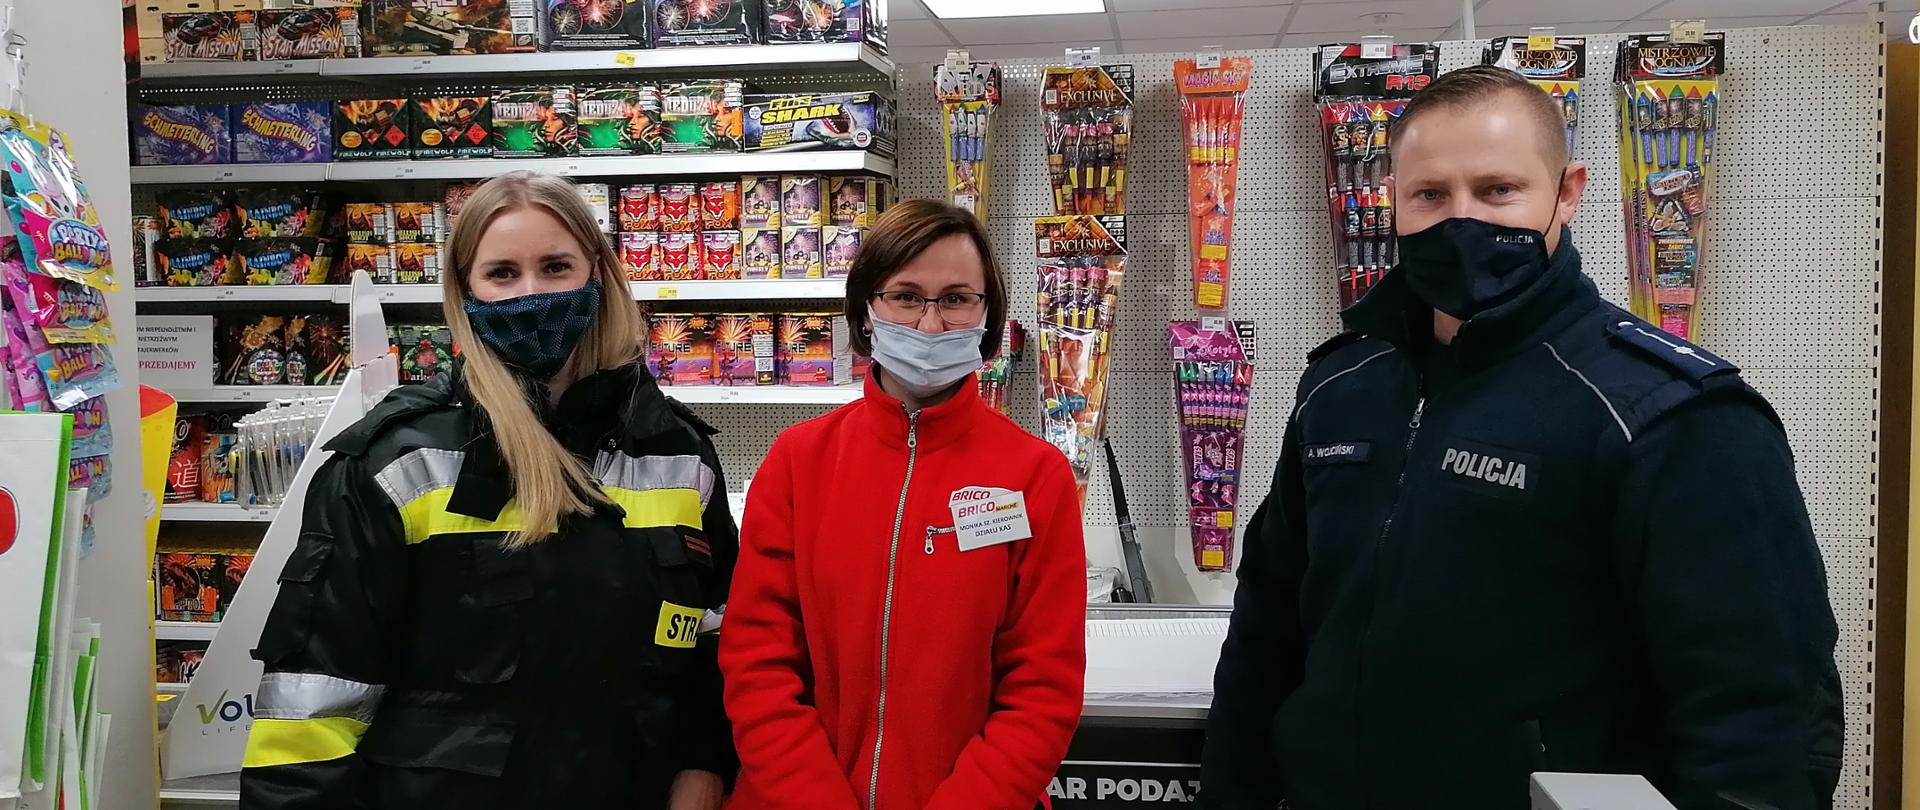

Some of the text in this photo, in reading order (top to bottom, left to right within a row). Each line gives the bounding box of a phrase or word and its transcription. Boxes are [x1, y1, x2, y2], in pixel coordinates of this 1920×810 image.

[167, 36, 240, 58] STAR MISSION
[265, 34, 342, 58] STAR MISSION
[1637, 46, 1715, 58] MISTRZOWIE
[1329, 54, 1425, 84] EXTREME
[1060, 89, 1117, 103] EXCLUSIVE
[761, 104, 842, 124] SHARK
[143, 112, 217, 154] SCHMETTERLING
[242, 108, 318, 151] SCHMETTERLING
[624, 219, 652, 230] FOX
[664, 221, 692, 231] FOX
[705, 218, 733, 229] FOX
[1053, 239, 1112, 253] EXCLUSIVE
[1495, 234, 1535, 244] POLICJA
[664, 270, 692, 280] FOX
[707, 270, 739, 280] FOX
[651, 342, 691, 353] FUTURE
[172, 458, 200, 488] 道
[1440, 448, 1527, 490] POLICJA
[952, 490, 991, 501] BRICO
[958, 501, 995, 518] BRICO
[999, 524, 1012, 533] KAS
[667, 613, 702, 642] STR
